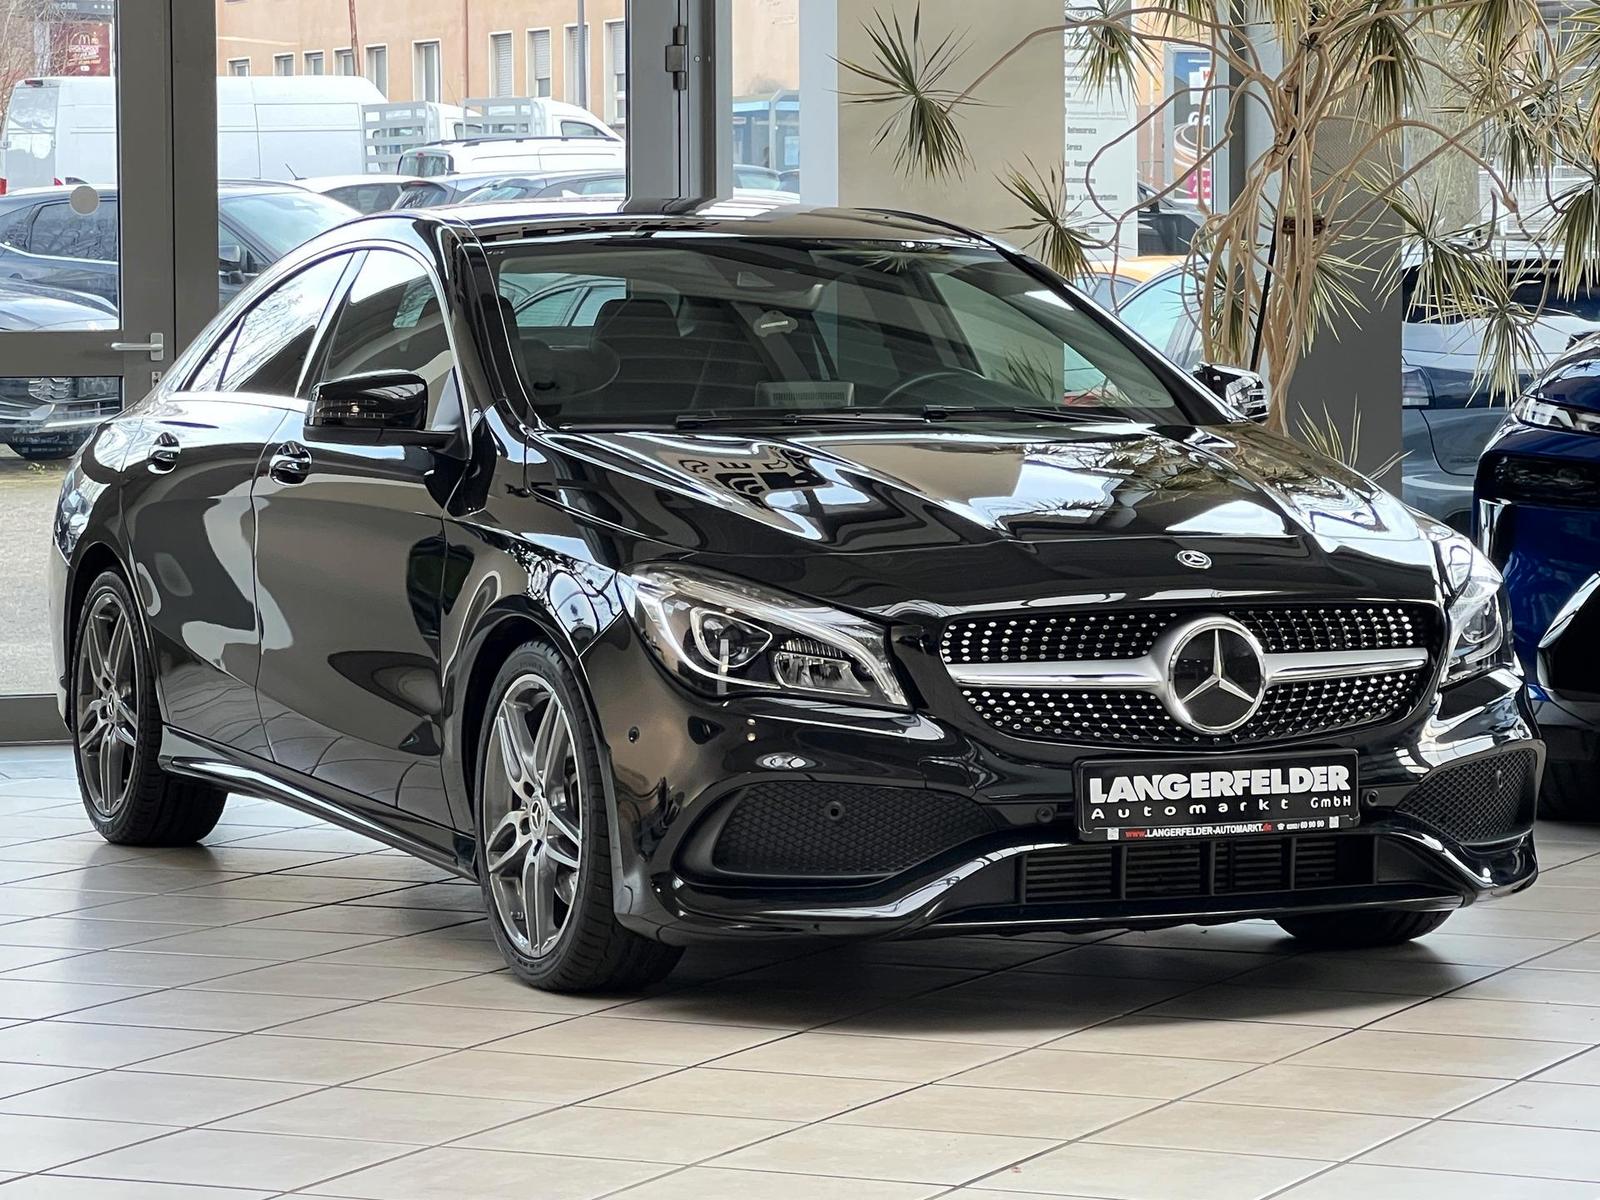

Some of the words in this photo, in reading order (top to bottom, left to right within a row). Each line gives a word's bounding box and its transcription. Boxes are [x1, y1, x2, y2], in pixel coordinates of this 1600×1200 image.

[1089, 765, 1351, 803] LANGERFELDER
[1091, 798, 1289, 819] Automarkt
[1310, 795, 1351, 809] GmbH
